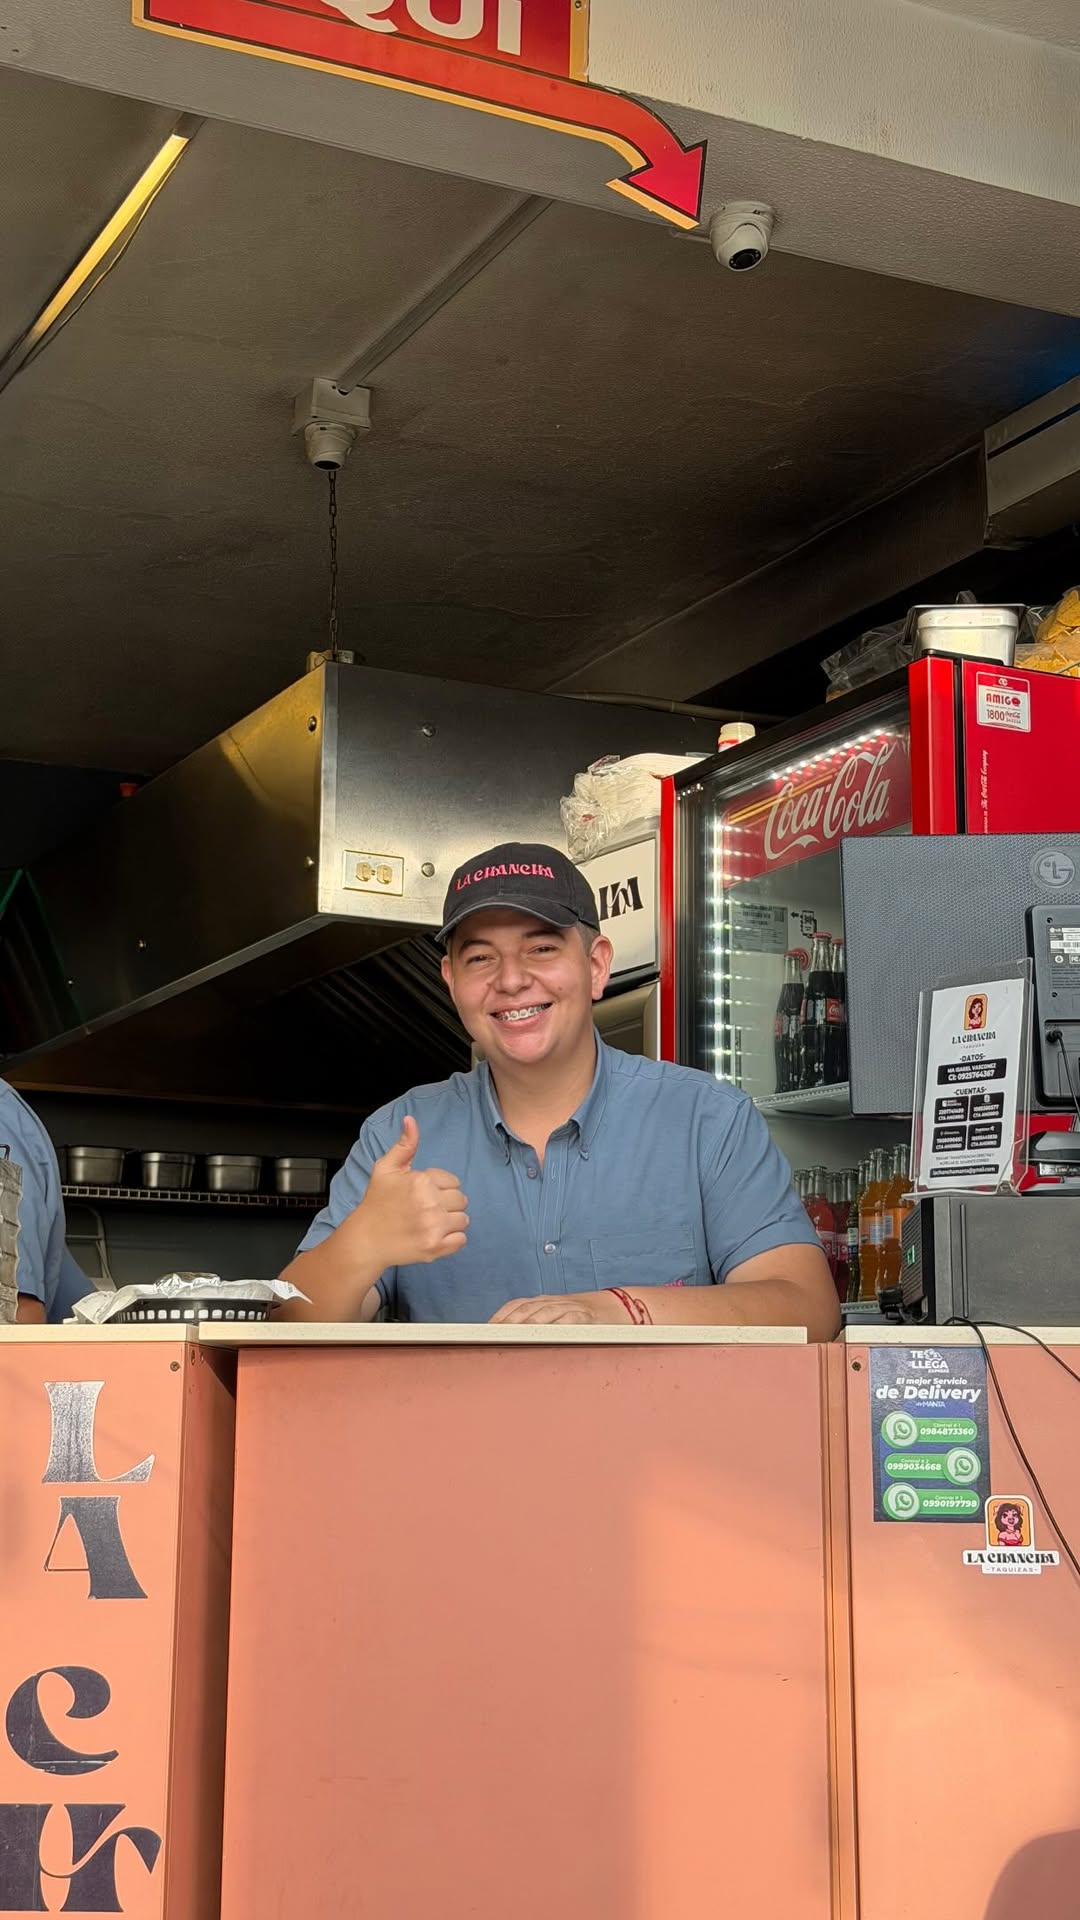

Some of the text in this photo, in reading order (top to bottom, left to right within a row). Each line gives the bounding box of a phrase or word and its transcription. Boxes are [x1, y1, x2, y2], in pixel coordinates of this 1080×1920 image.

[986, 709, 1005, 721] 1800
[764, 742, 897, 860] Coca-Cola
[455, 863, 555, 891] LA CHANCHA
[910, 1350, 925, 1359] TE
[911, 1360, 949, 1369] LLEGA
[896, 1377, 968, 1387] El mejor Servicio
[875, 1385, 982, 1403] de Delivery
[967, 1552, 1056, 1564] LA CHANCHA
